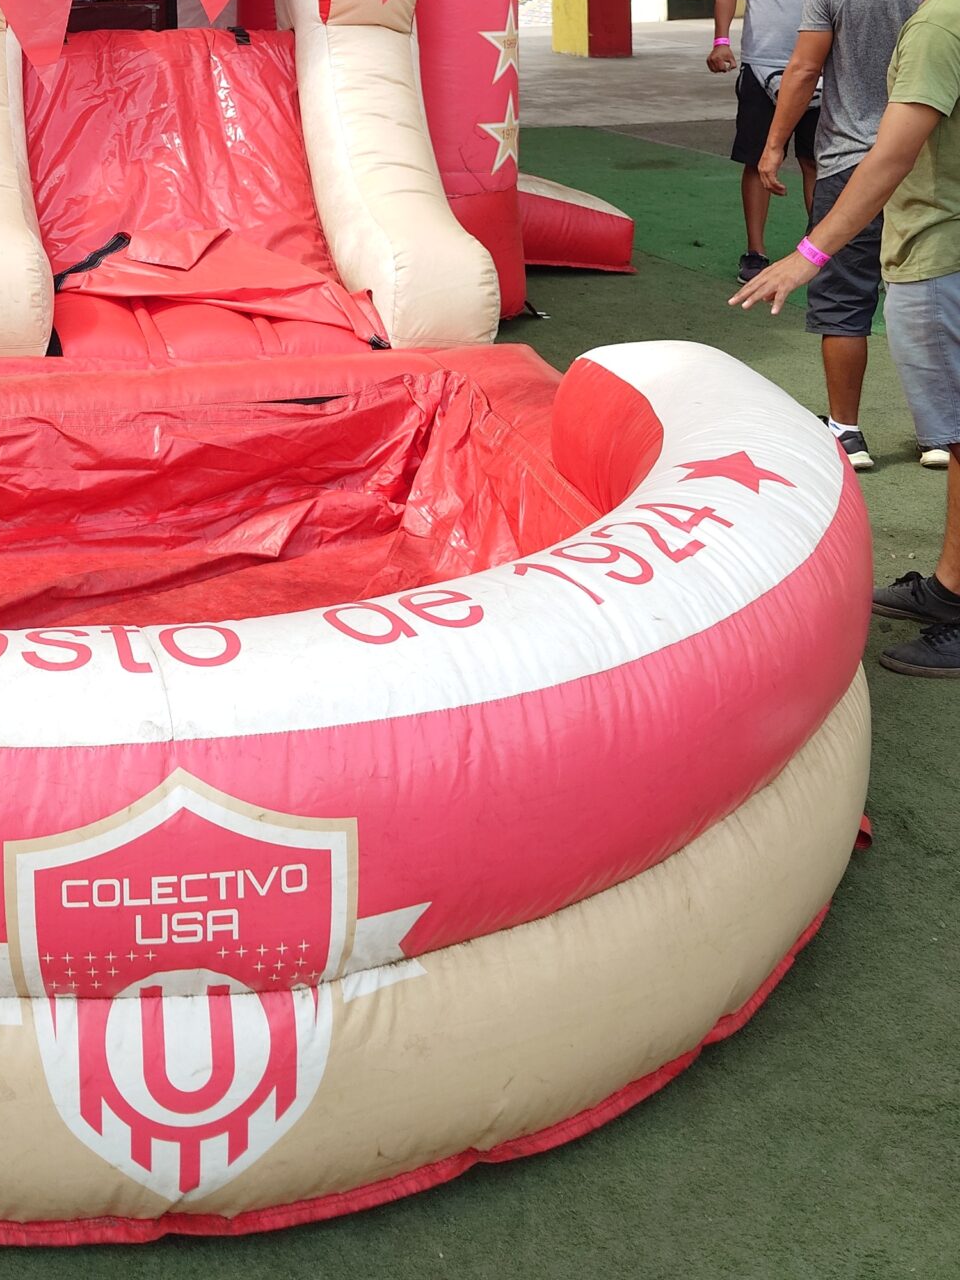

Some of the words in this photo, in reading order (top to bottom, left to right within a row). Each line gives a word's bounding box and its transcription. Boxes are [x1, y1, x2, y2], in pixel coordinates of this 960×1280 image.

[321, 588, 484, 645] de
[513, 503, 734, 605] 1924
[61, 863, 308, 908] COLECTIVO
[135, 908, 240, 945] USA
[140, 984, 235, 1114] U
